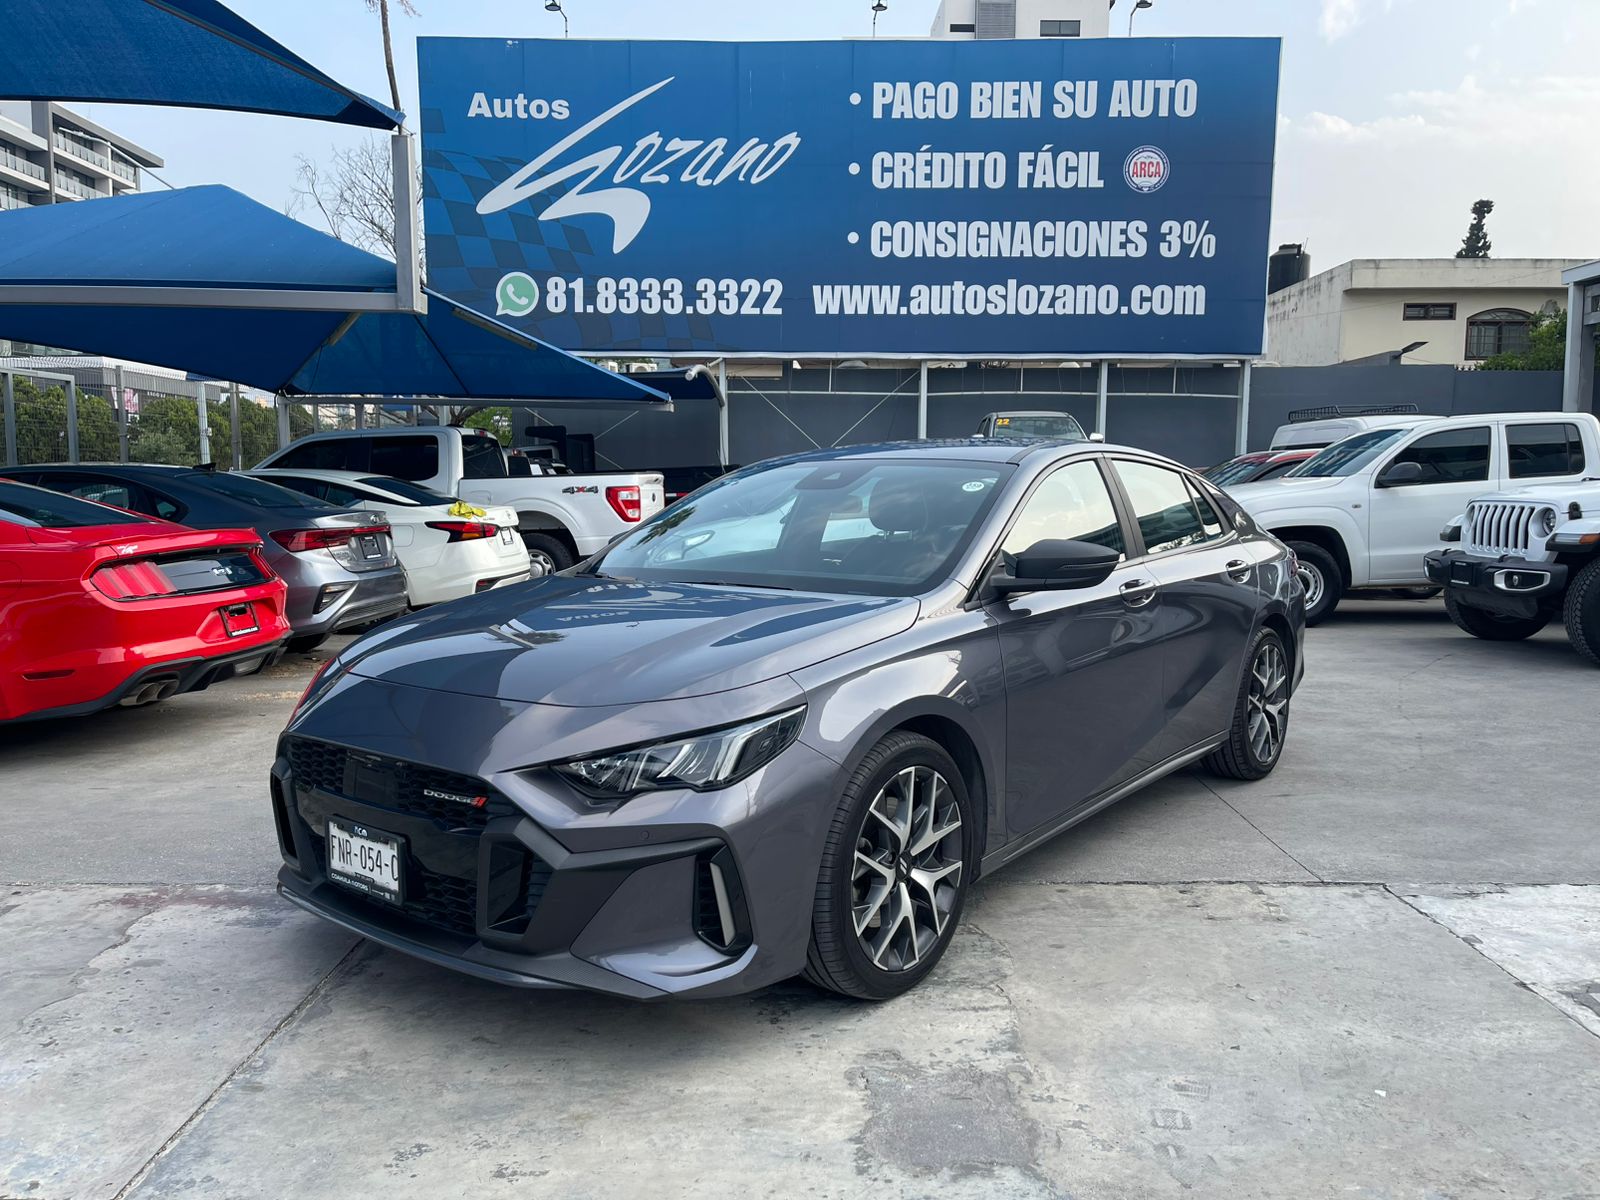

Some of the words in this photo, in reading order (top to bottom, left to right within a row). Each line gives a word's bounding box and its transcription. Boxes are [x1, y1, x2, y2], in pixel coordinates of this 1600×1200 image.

[467, 92, 570, 120] Autos
[873, 81, 959, 120] PAGO
[970, 80, 1042, 119] BIEN
[1053, 80, 1098, 118] SU
[1108, 78, 1198, 118] AUTO
[871, 144, 1006, 190] CRÉDITO
[1017, 143, 1104, 189] FÁCIL
[1132, 160, 1161, 178] ARCA
[870, 220, 1147, 258] CONSIGNACIONES
[1159, 219, 1216, 258] 3%
[546, 276, 783, 315] 81.8333.3322
[812, 278, 1206, 316] www.autoslozano.com
